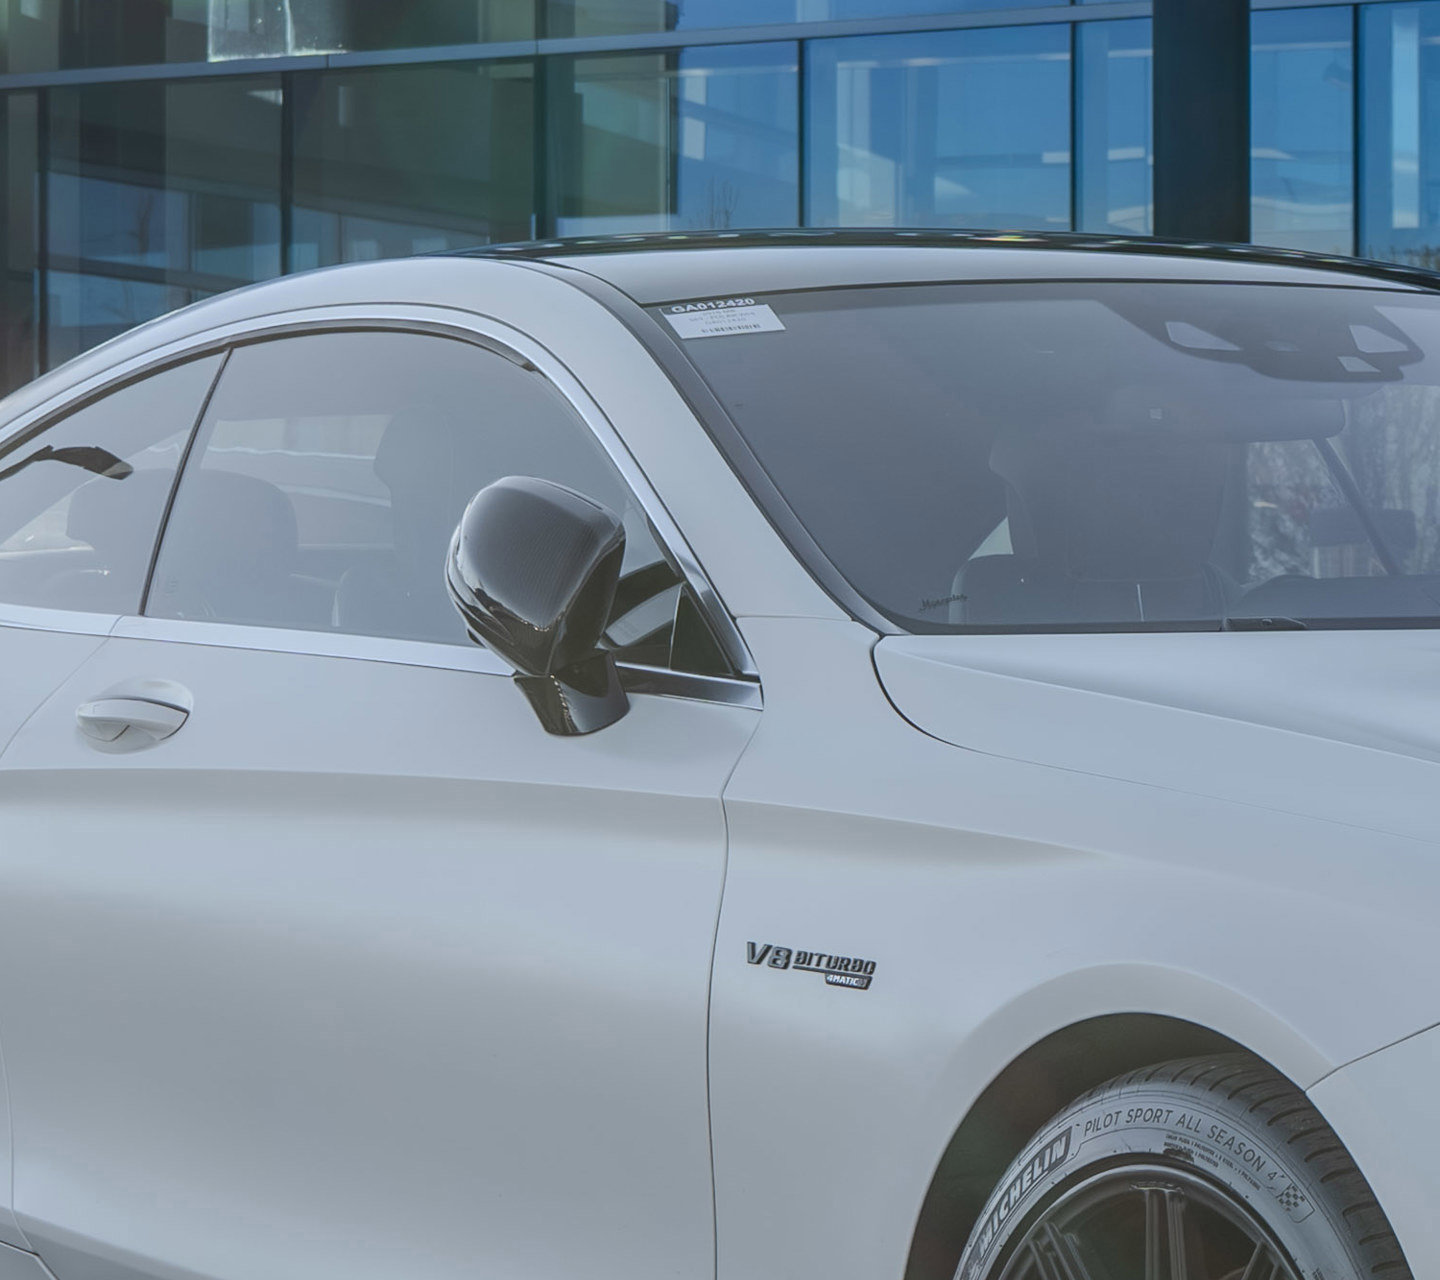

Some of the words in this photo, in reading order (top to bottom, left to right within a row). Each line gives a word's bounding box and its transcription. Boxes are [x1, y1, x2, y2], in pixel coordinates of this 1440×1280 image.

[671, 298, 755, 313] GA012420
[746, 941, 792, 969] V8
[793, 950, 877, 975] BITURBO
[976, 1134, 1069, 1259] MICHELIN
[1083, 1110, 1121, 1137] PILOT
[1125, 1107, 1173, 1124] SPORT
[1175, 1112, 1204, 1133] ALL
[1207, 1125, 1266, 1172] SEASON
